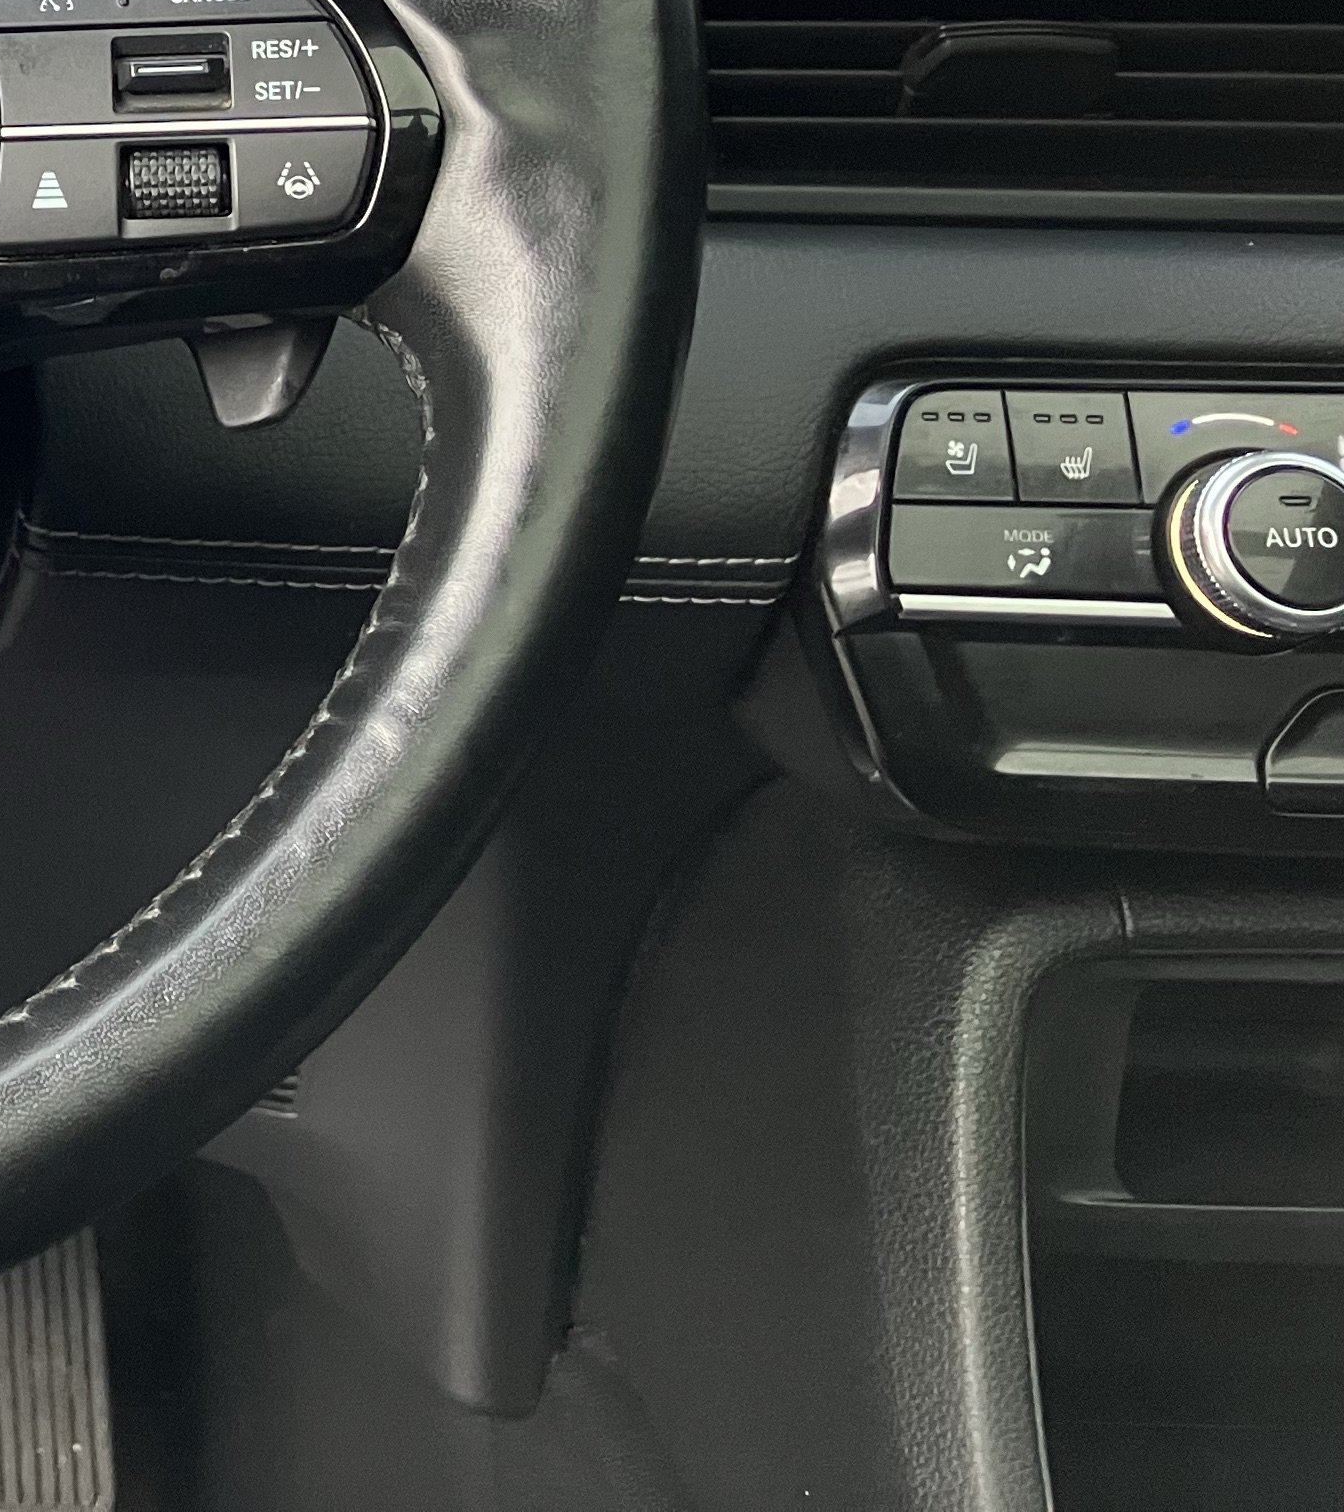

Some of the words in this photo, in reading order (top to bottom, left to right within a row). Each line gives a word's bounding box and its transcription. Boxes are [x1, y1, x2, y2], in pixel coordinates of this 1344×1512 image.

[250, 38, 319, 61] RES/+
[1004, 530, 1054, 544] MODE
[1265, 528, 1339, 549] AUTO
